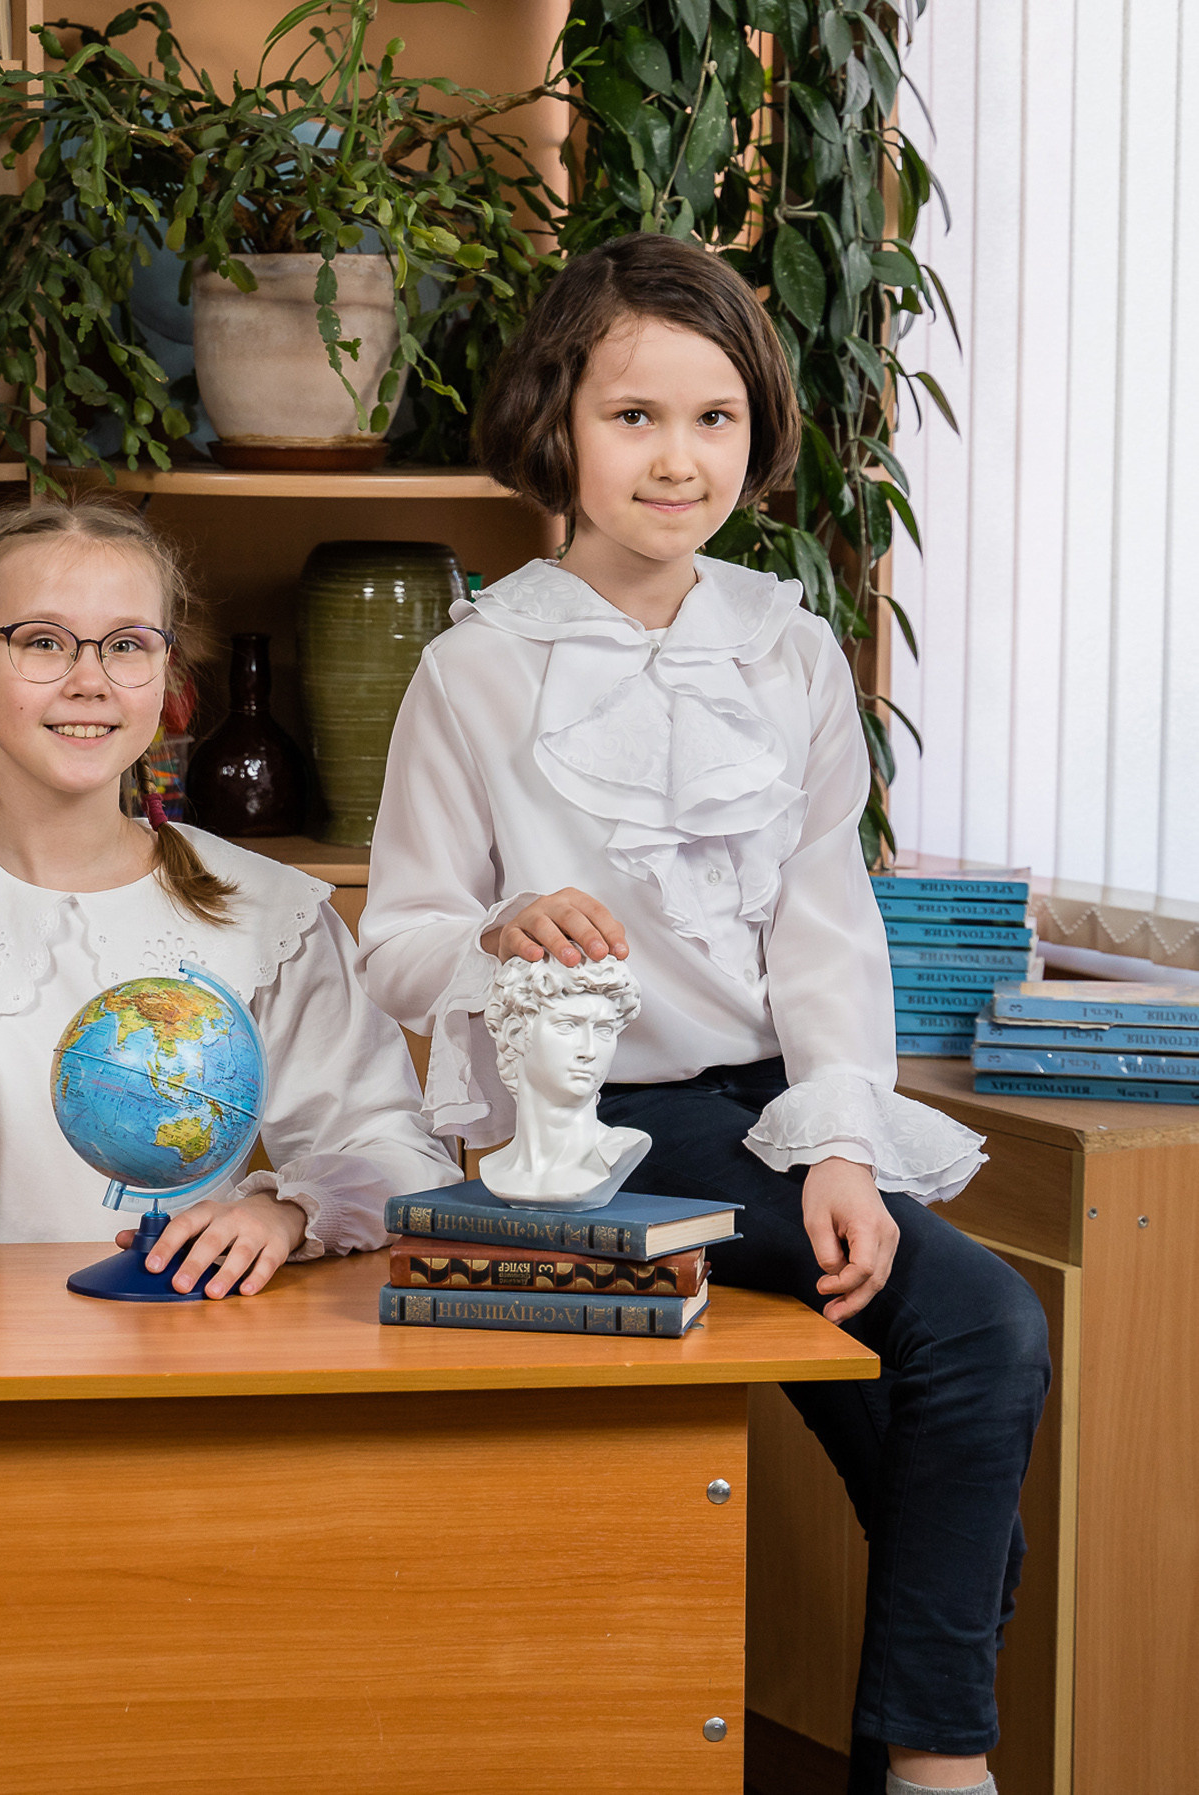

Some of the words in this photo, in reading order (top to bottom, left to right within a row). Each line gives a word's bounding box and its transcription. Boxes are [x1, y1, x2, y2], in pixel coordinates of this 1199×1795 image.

[1010, 1004, 1023, 1013] 3
[988, 1055, 1001, 1063] 3
[436, 1213, 521, 1238] ПУШКИН
[498, 1262, 531, 1273] КУПЕР
[538, 1264, 554, 1274] 3
[436, 1299, 535, 1322] ПУШКИН
